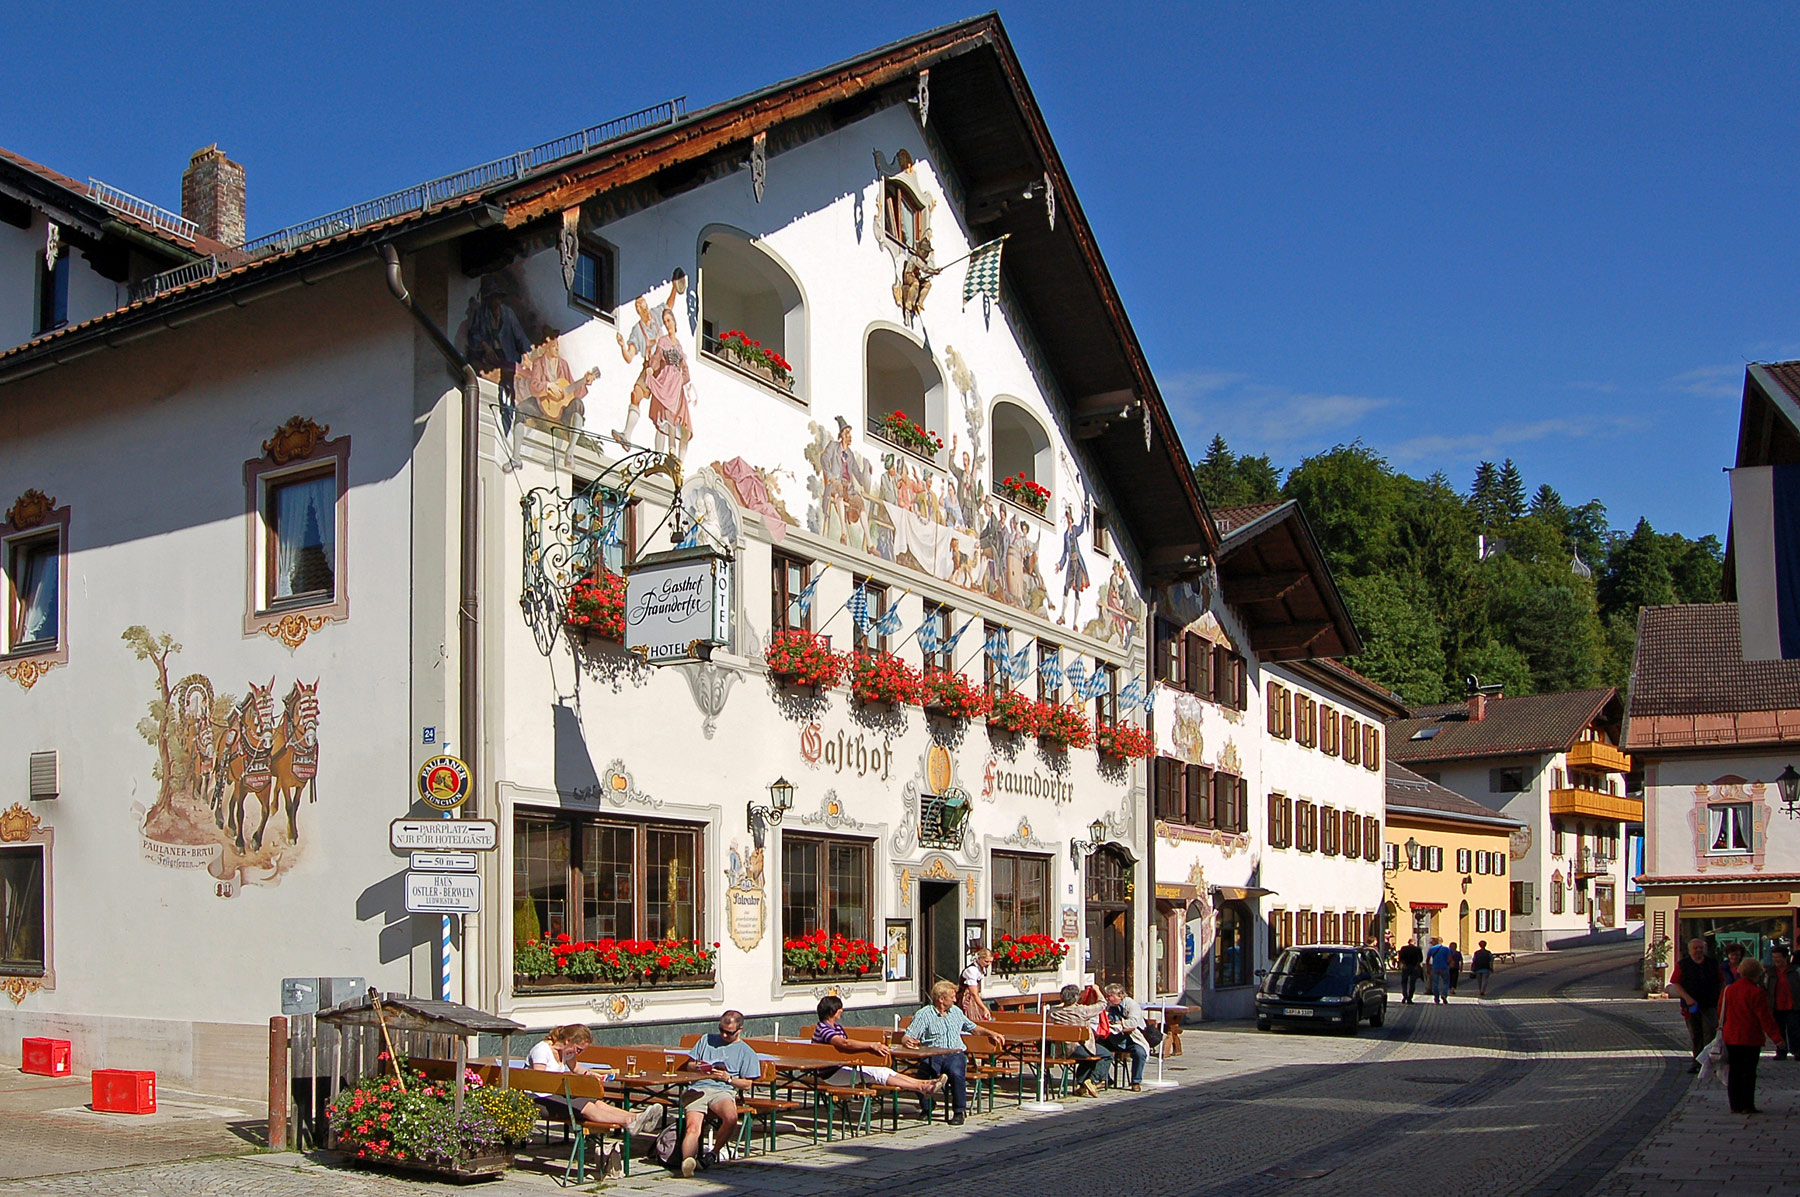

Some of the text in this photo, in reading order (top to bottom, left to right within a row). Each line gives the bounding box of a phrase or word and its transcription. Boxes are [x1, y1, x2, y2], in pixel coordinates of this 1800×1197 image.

[658, 574, 704, 602] Gasthof
[718, 561, 728, 640] HOTEL
[650, 642, 688, 658] HOTEL
[424, 729, 434, 738] 24
[800, 722, 894, 782] Gasthof
[421, 758, 467, 780] PAULANER
[981, 753, 1074, 805] Fraundorfer
[424, 790, 463, 806] MÜNCHEN
[420, 823, 469, 834] PARKPLATZ
[396, 833, 492, 845] NUR FÜR HOTELGÄSTE
[434, 857, 444, 866] 50
[434, 876, 453, 887] HAUS
[412, 886, 439, 897] OSTLER
[443, 887, 474, 898] BERWEIN
